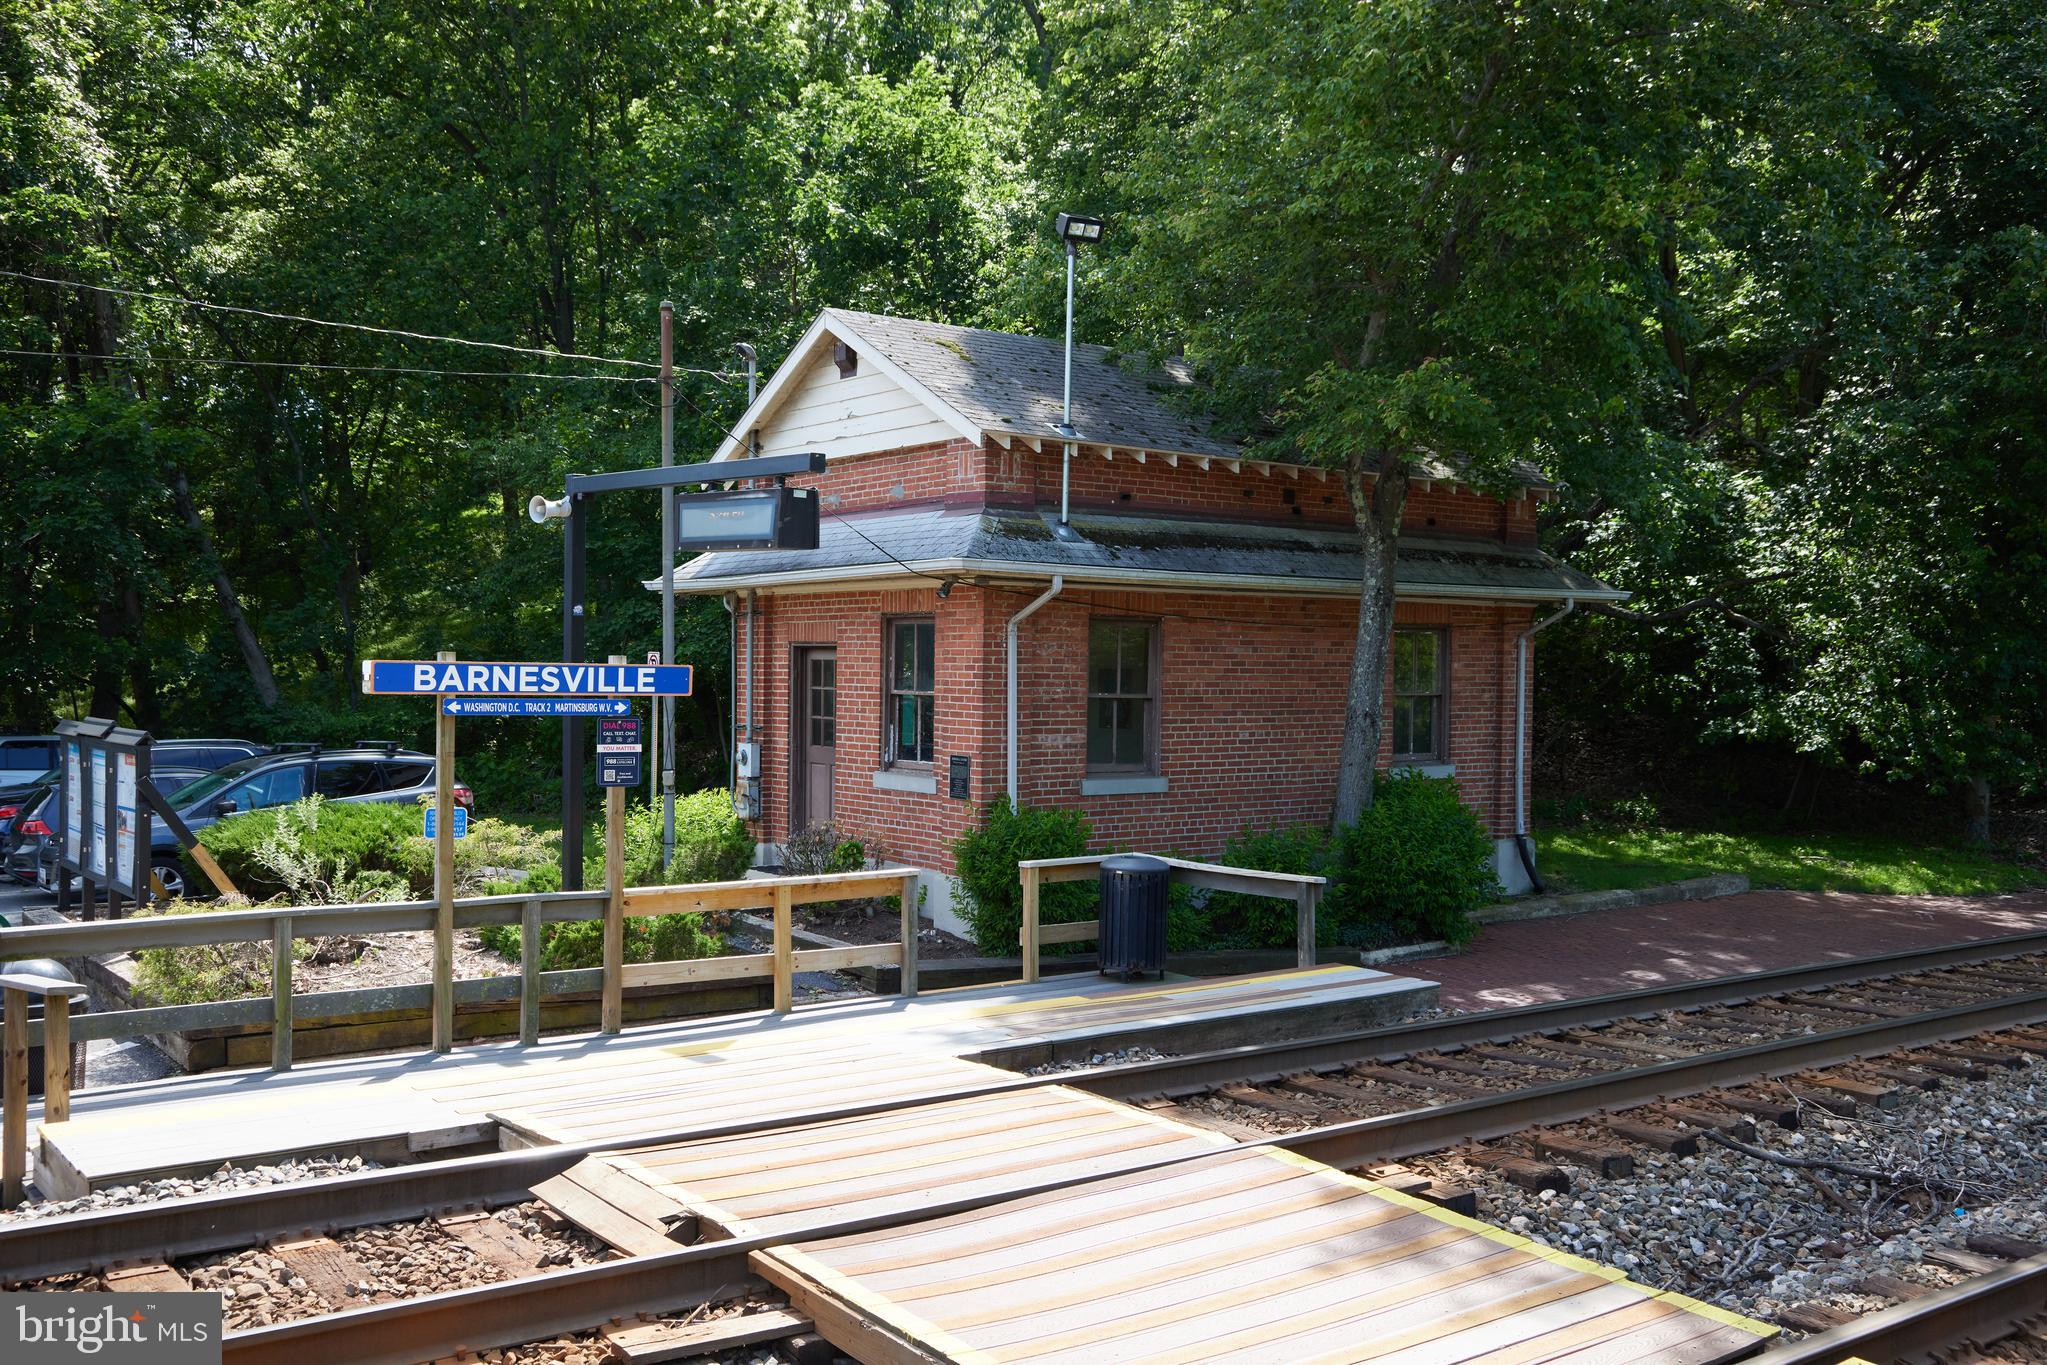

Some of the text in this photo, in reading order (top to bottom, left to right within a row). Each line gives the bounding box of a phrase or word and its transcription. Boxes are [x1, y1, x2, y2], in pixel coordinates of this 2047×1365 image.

[413, 664, 656, 693] BARNESVILLE
[463, 702, 613, 712] WASHINGTON D.C. TRACK 2 MARTINSBURG W.V.
[603, 722, 637, 730] DIAL 988
